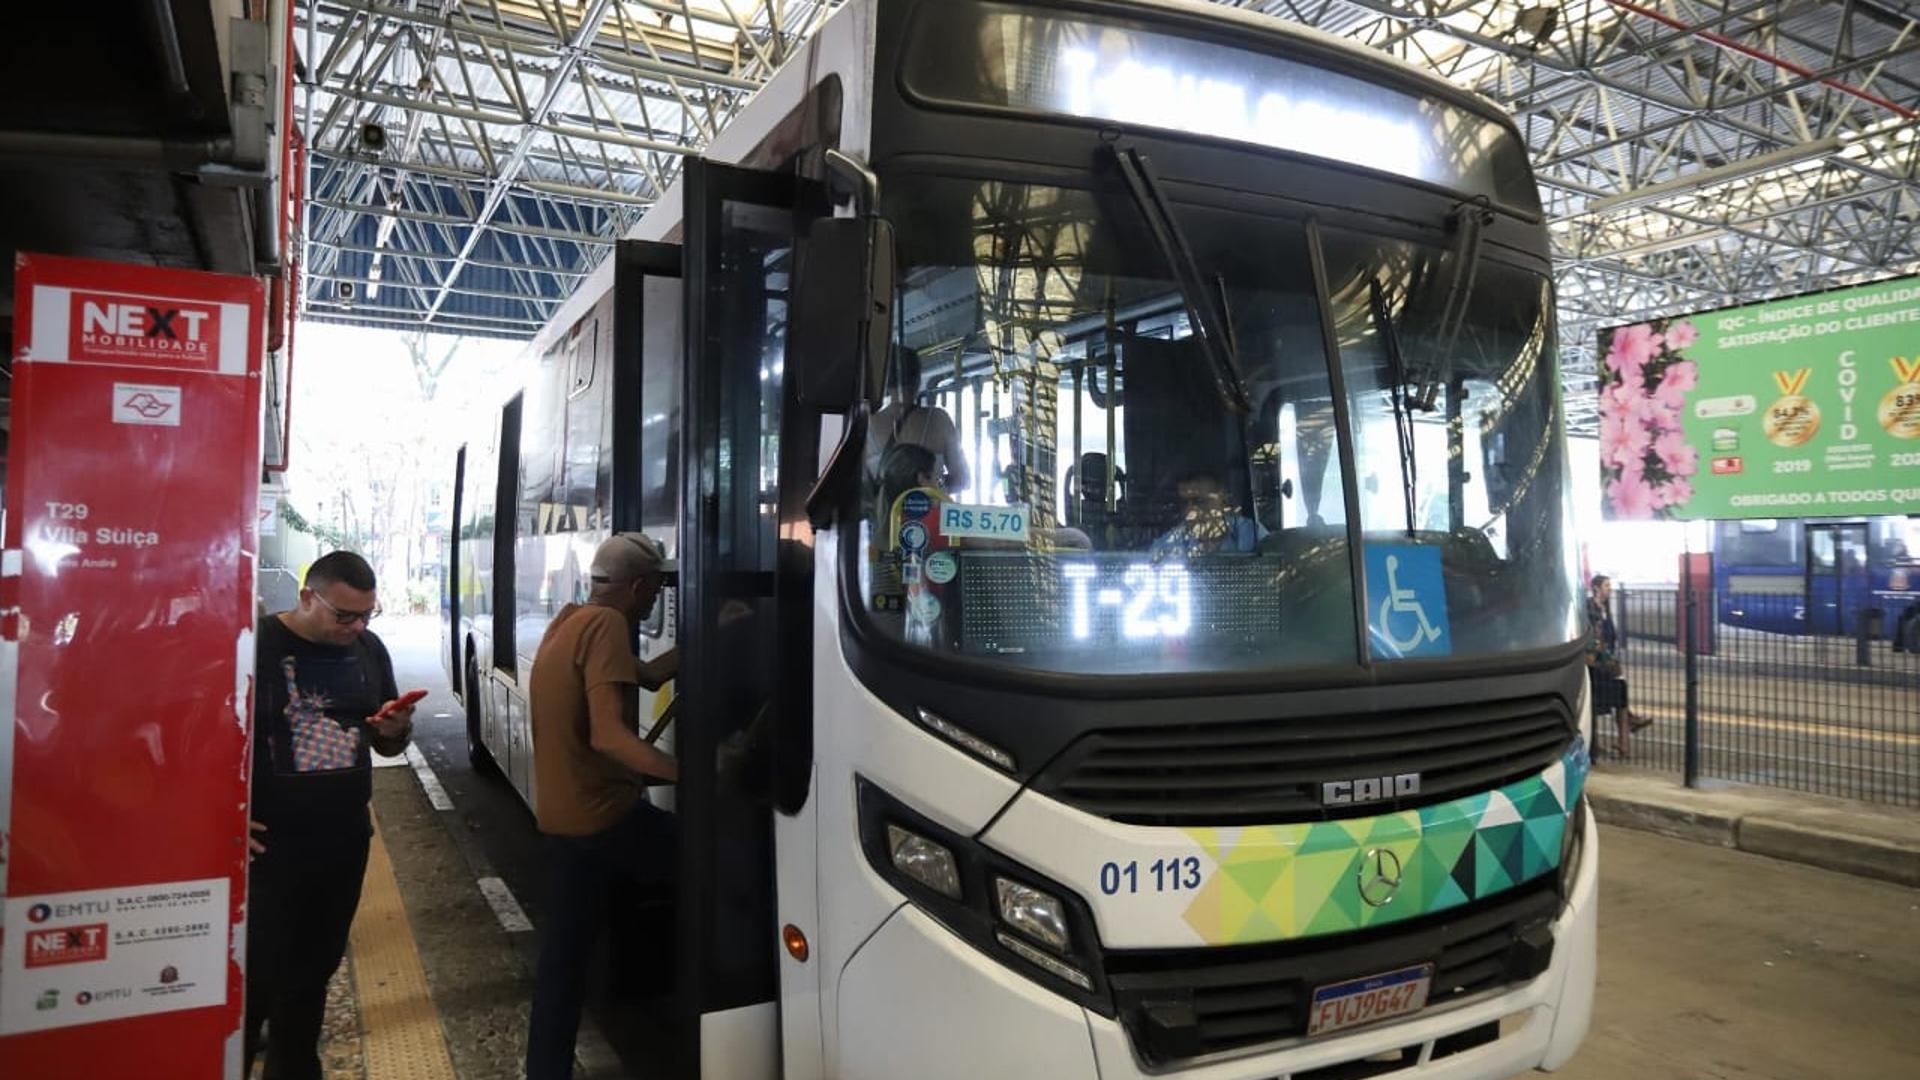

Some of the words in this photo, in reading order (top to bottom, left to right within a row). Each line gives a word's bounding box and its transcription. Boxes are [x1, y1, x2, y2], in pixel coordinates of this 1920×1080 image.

[83, 301, 208, 341] NEXT
[1718, 315, 1745, 331] IQC
[1818, 300, 1840, 314] DE
[1718, 322, 1811, 349] SATISFAÇÃO
[1815, 320, 1842, 335] DO
[1845, 308, 1920, 331] CLIENTE
[82, 333, 209, 353] MOBILIDADE
[46, 501, 89, 519] T29
[1730, 491, 1811, 506] OBRIGADO
[1813, 492, 1826, 504] A
[1826, 488, 1887, 503] TODOS
[980, 512, 1022, 533] 5,70
[1062, 563, 1192, 640] T-29
[1323, 773, 1420, 804] CAIO
[1101, 861, 1138, 895] 01
[1150, 856, 1201, 892] 113
[55, 901, 110, 918] EMTU
[32, 928, 101, 952] NEXT
